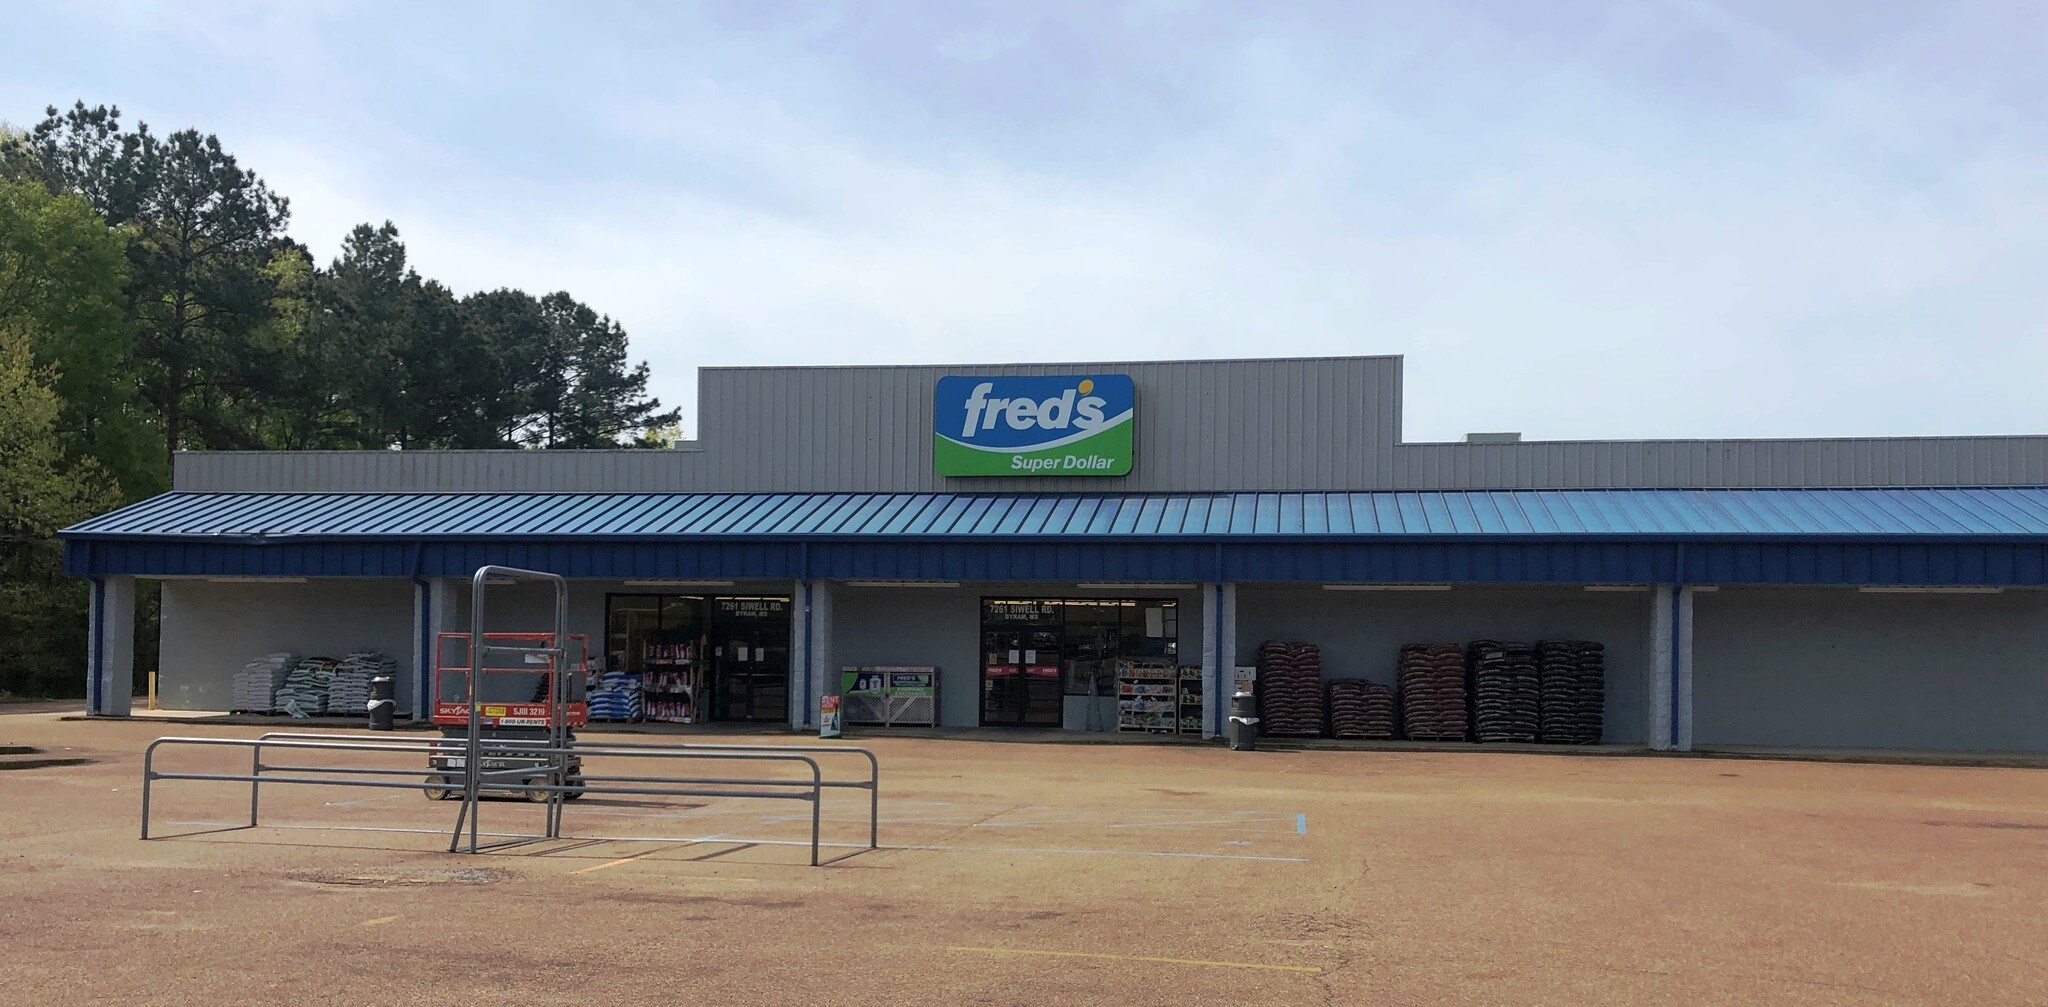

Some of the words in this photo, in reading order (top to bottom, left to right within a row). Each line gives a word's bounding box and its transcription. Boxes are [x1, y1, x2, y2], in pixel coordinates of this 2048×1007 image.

[961, 379, 1107, 437] fred's
[1011, 455, 1060, 472] Super
[1063, 454, 1115, 470] Dollar
[721, 602, 738, 610] 7261
[740, 602, 768, 611] SIWELL
[770, 602, 783, 611] RD.
[990, 605, 1008, 613] 7261
[1010, 605, 1039, 613] SIWELL
[1041, 605, 1055, 614] RD.
[821, 695, 839, 704] RENT
[439, 705, 470, 715] SKYJAC
[529, 708, 545, 716] 3219
